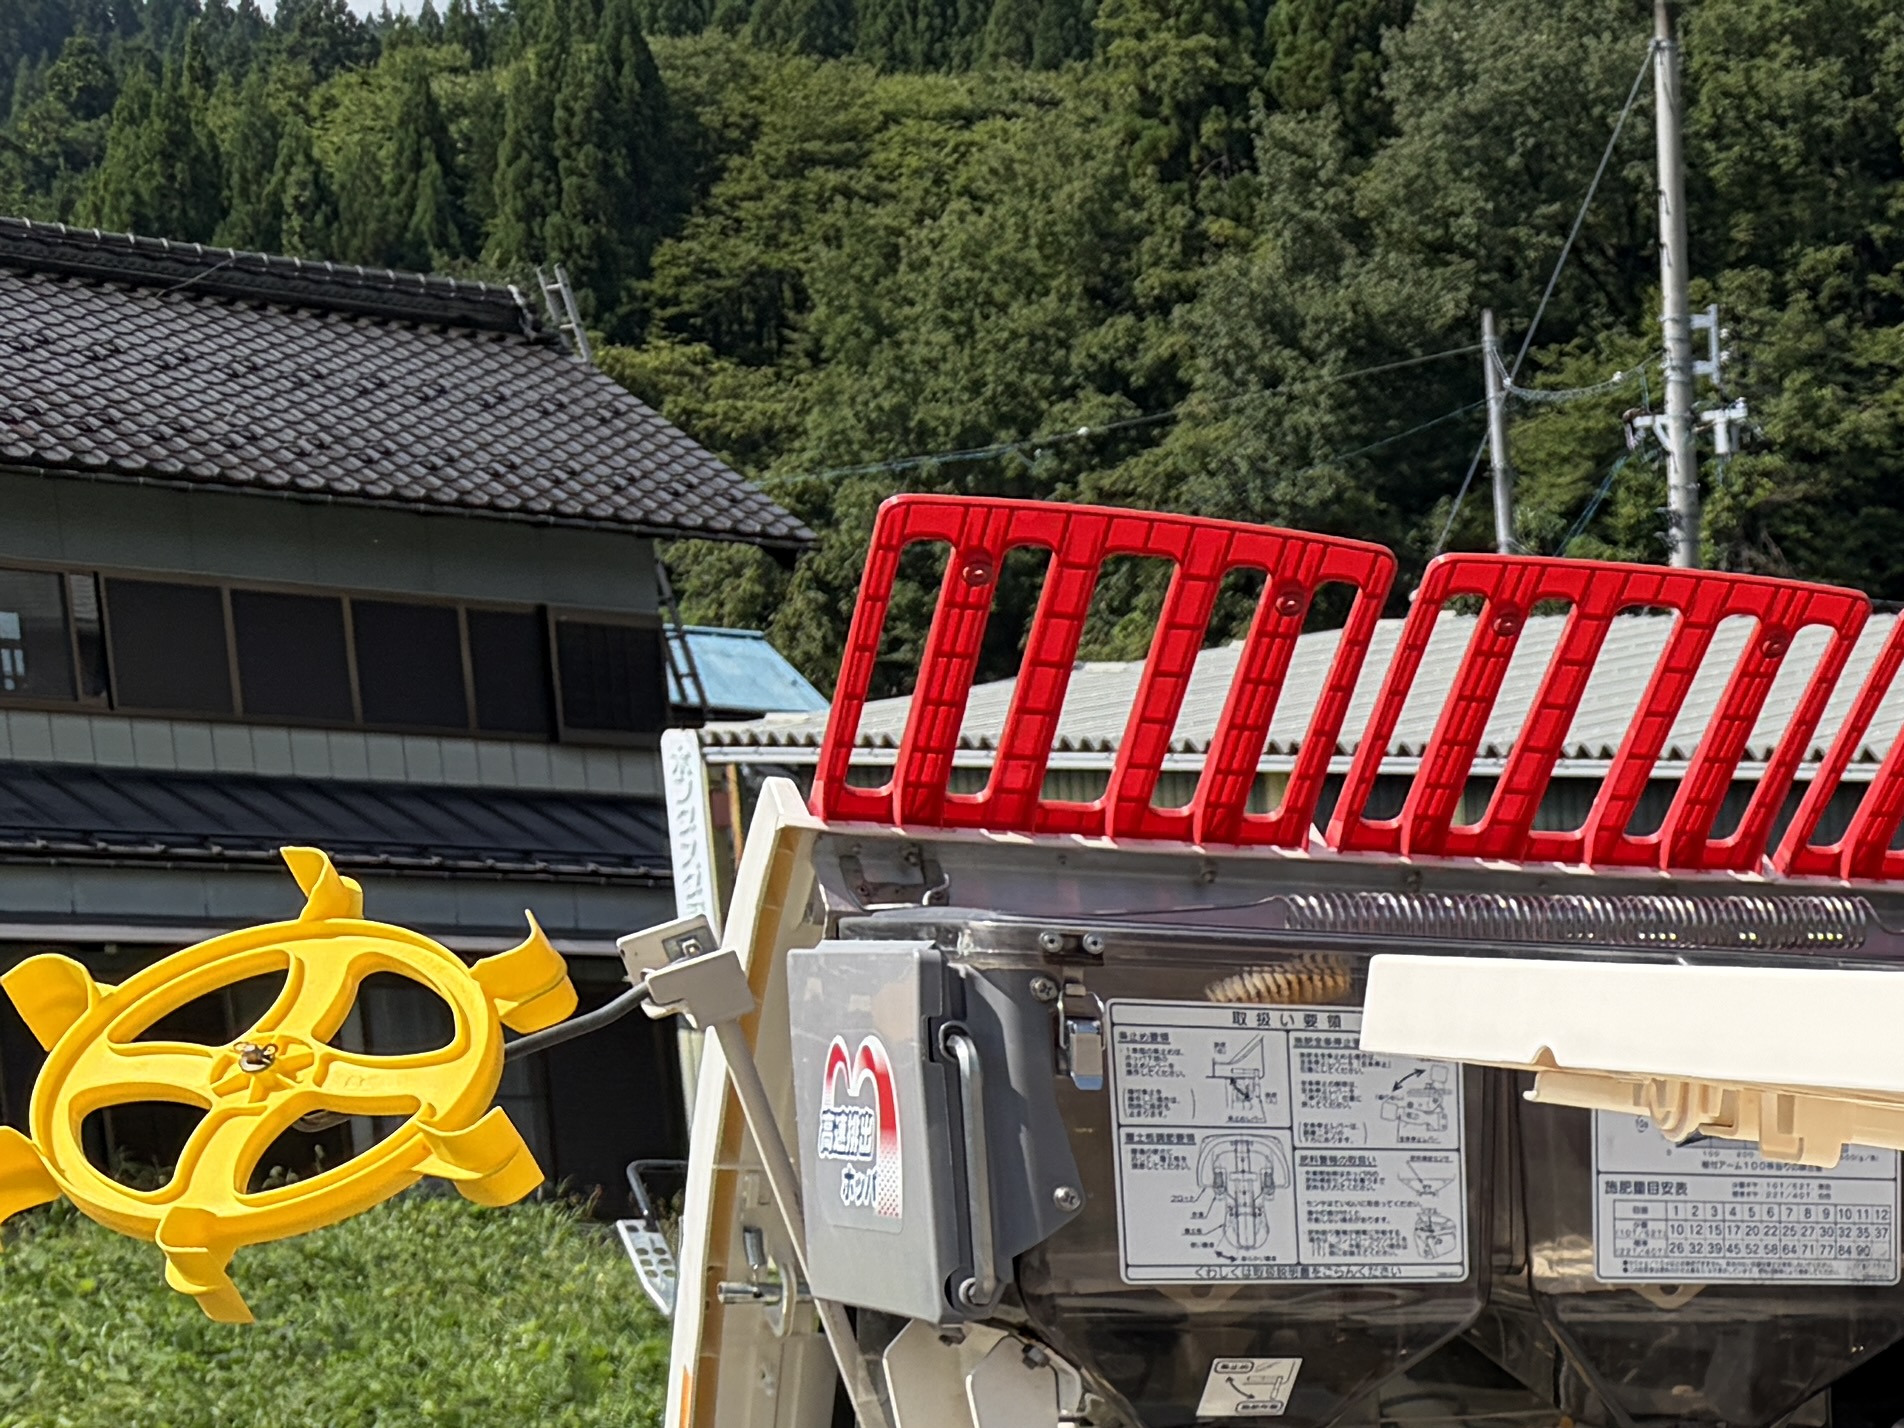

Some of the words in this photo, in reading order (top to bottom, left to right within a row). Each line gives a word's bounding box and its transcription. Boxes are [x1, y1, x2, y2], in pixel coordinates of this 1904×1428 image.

[1232, 1011, 1341, 1029] 取扱い要領
[818, 1106, 874, 1161] 高速排出
[1604, 1179, 1689, 1196] 施肥量目安表
[1838, 1208, 1852, 1220] 10
[1857, 1209, 1869, 1221] 11
[1875, 1209, 1888, 1221] 12
